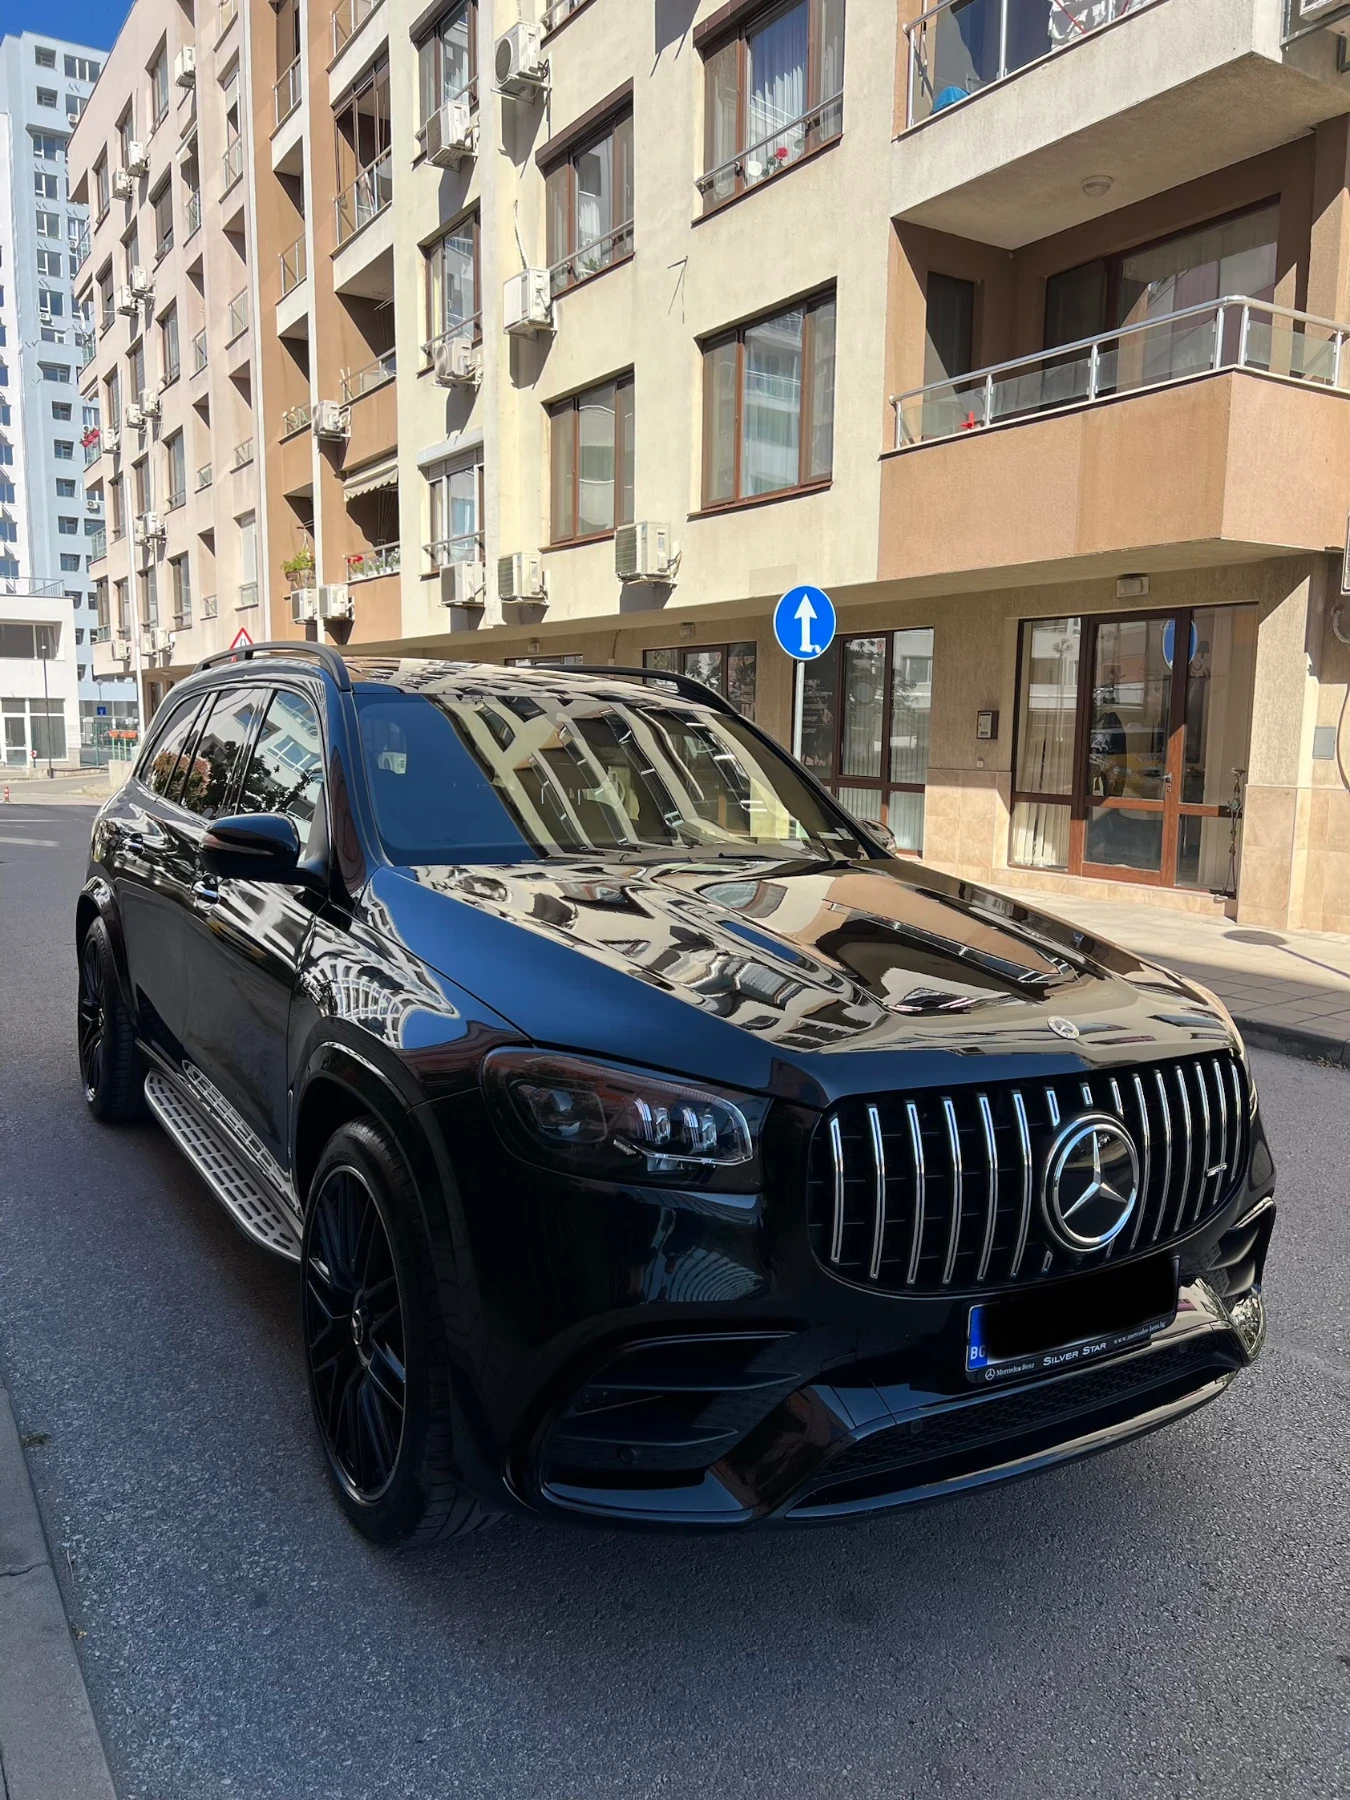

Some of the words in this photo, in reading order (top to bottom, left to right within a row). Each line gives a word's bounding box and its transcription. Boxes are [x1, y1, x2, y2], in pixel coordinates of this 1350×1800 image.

[970, 1345, 986, 1360] BG
[1043, 1350, 1079, 1366] SILVER
[1082, 1342, 1107, 1355] STAR
